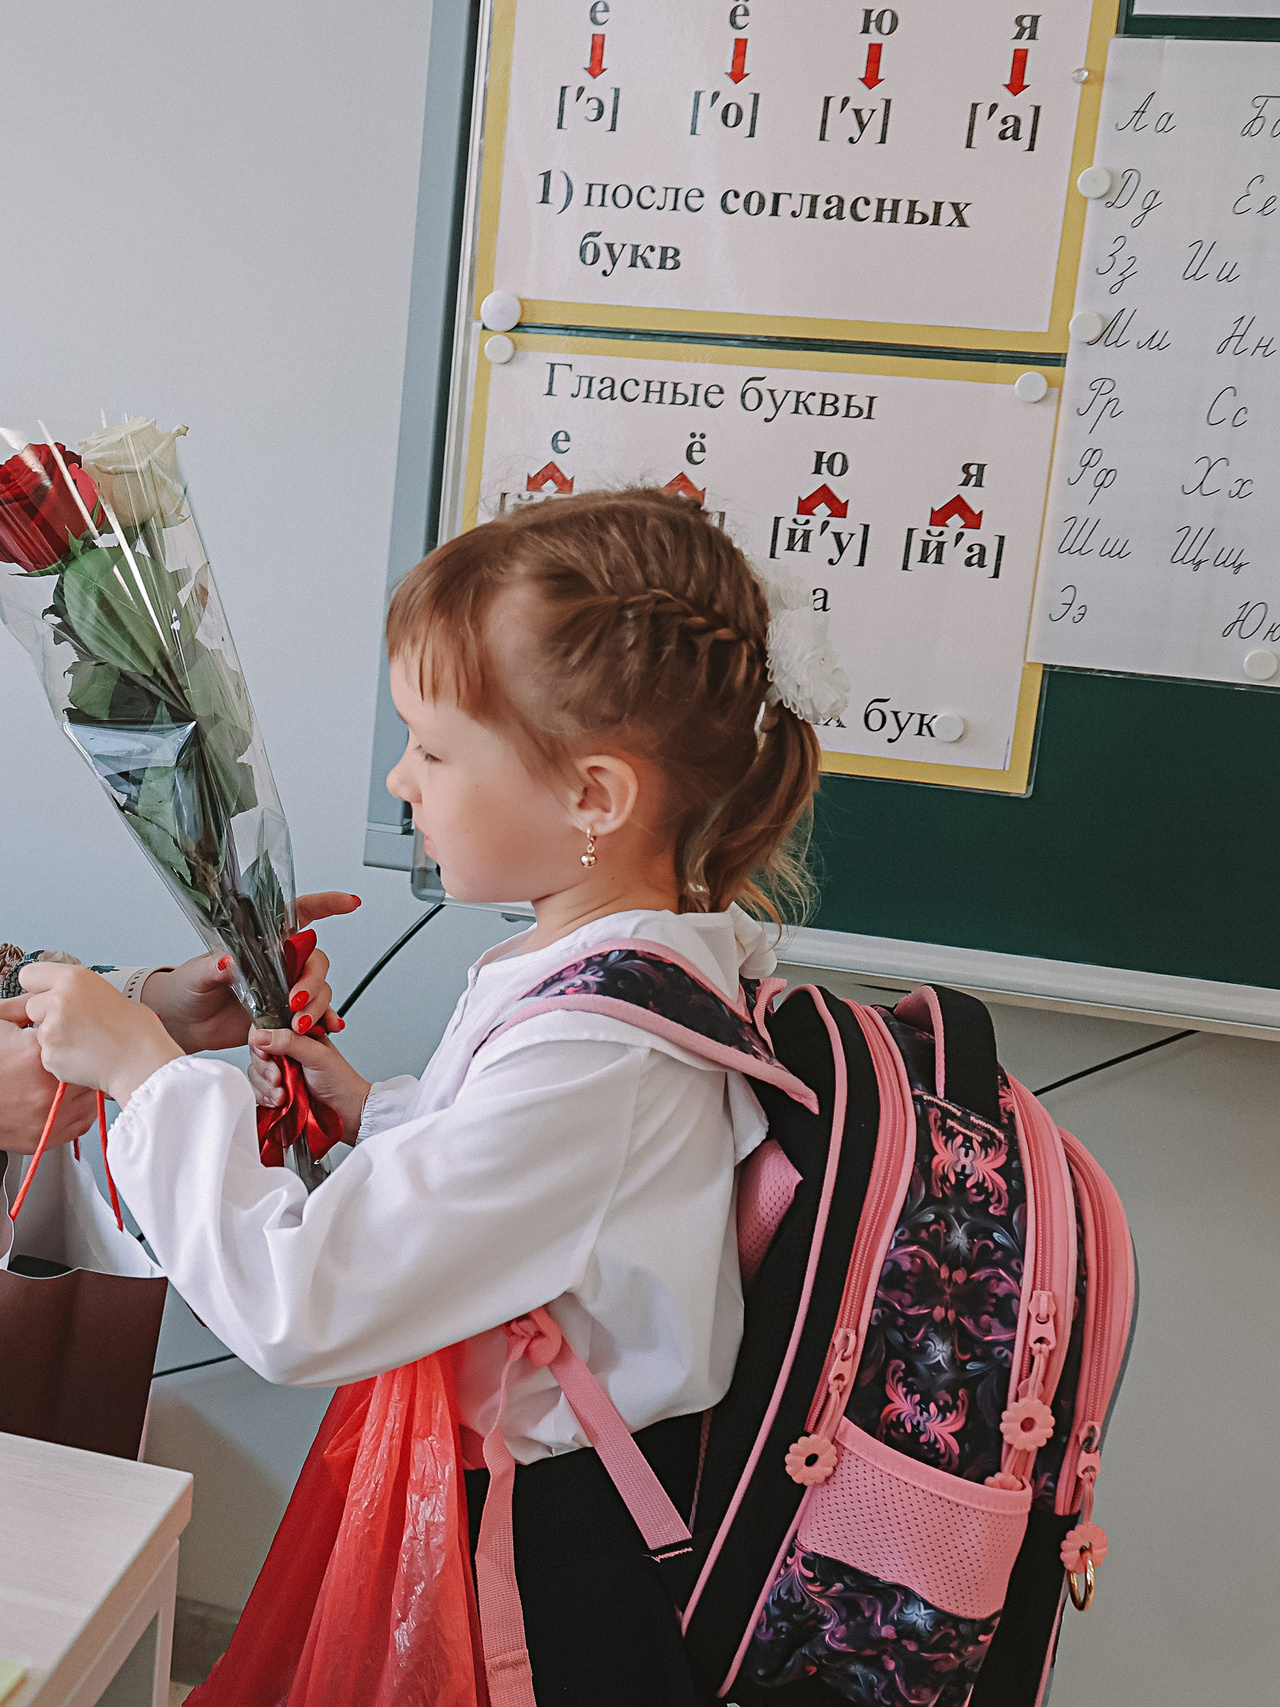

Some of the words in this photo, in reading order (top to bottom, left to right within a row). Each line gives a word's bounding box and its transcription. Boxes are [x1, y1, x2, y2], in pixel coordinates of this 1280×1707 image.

[859, 8, 899, 36] ю
[1011, 14, 1042, 41] я
[536, 169, 574, 215] 1)
[583, 182, 705, 213] после
[720, 188, 973, 228] согласных
[579, 231, 682, 277] букв
[542, 362, 725, 409] Гласные
[740, 376, 879, 423] буквы
[551, 429, 571, 454] е
[685, 432, 707, 465] ё
[811, 450, 849, 477] ю
[958, 462, 988, 488] я
